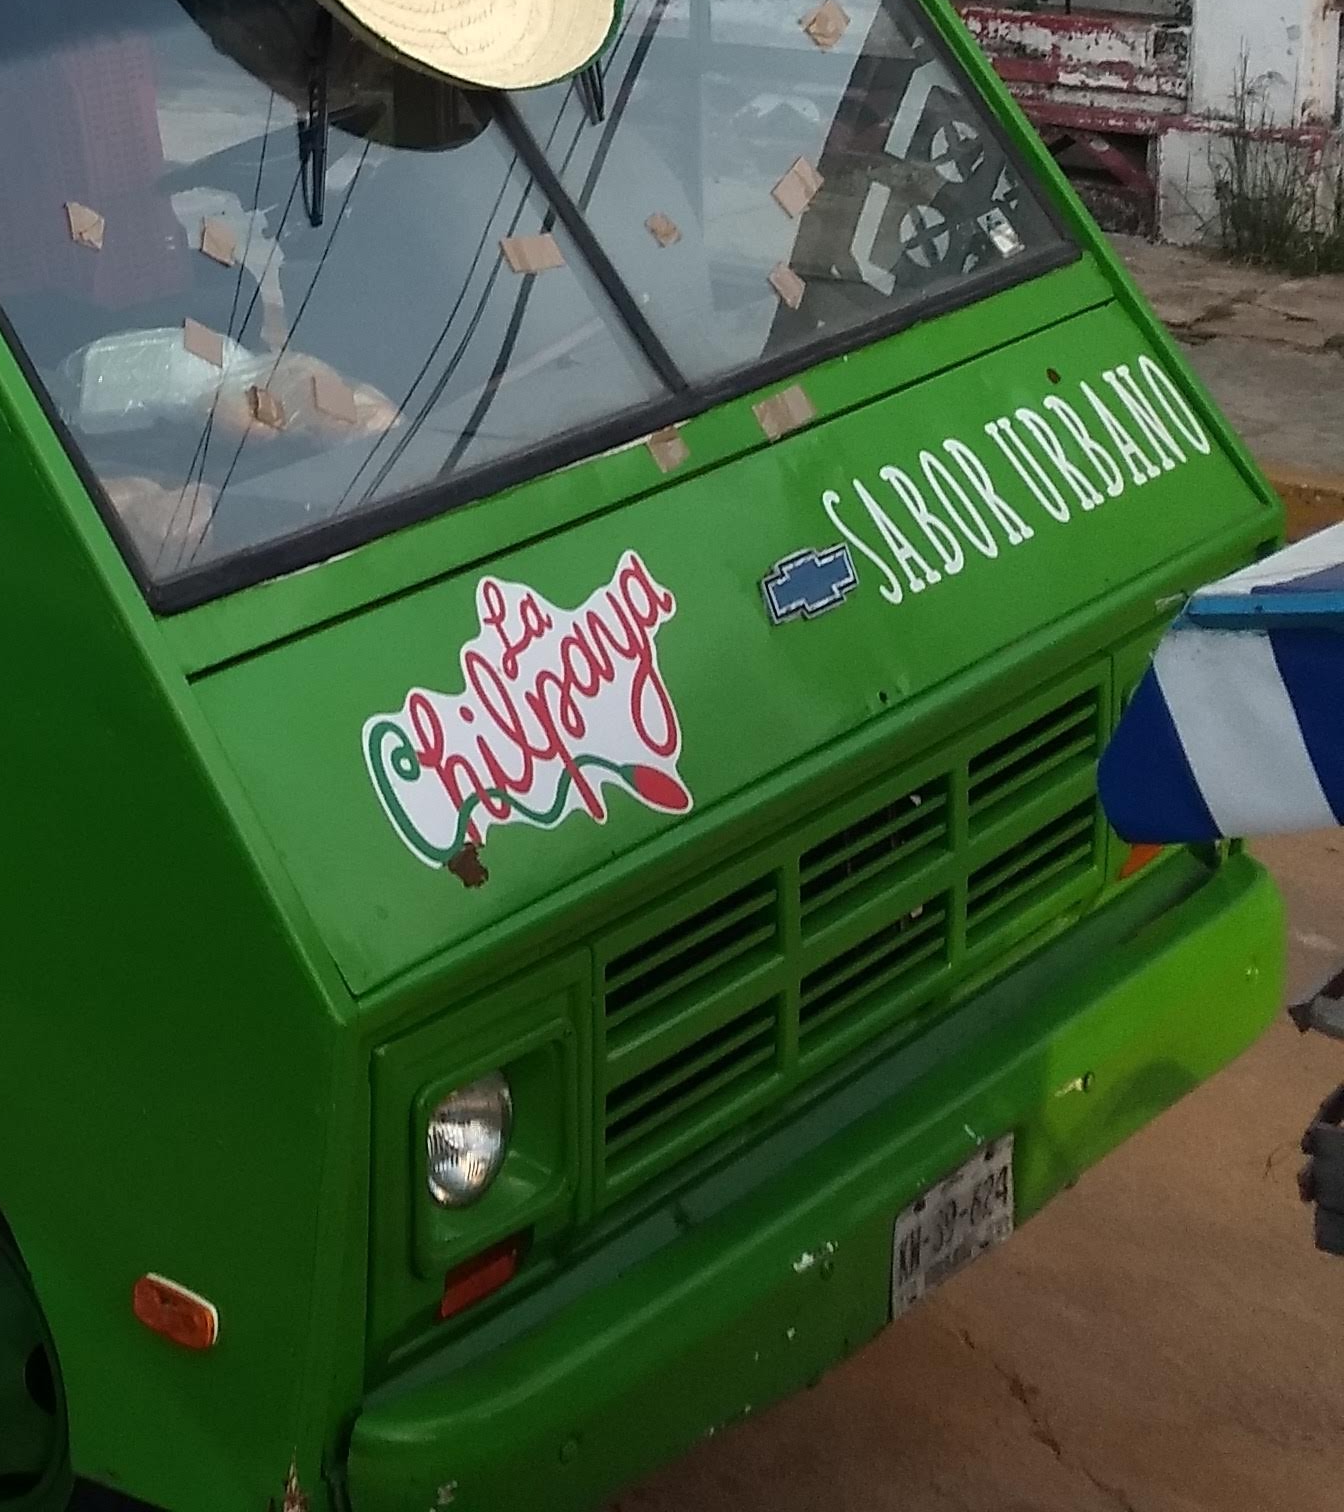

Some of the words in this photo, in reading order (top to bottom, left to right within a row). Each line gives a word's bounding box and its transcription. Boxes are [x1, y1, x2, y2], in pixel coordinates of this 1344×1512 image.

[822, 438, 1035, 605] SABOR
[984, 355, 1211, 523] URBANO
[482, 580, 553, 681] La
